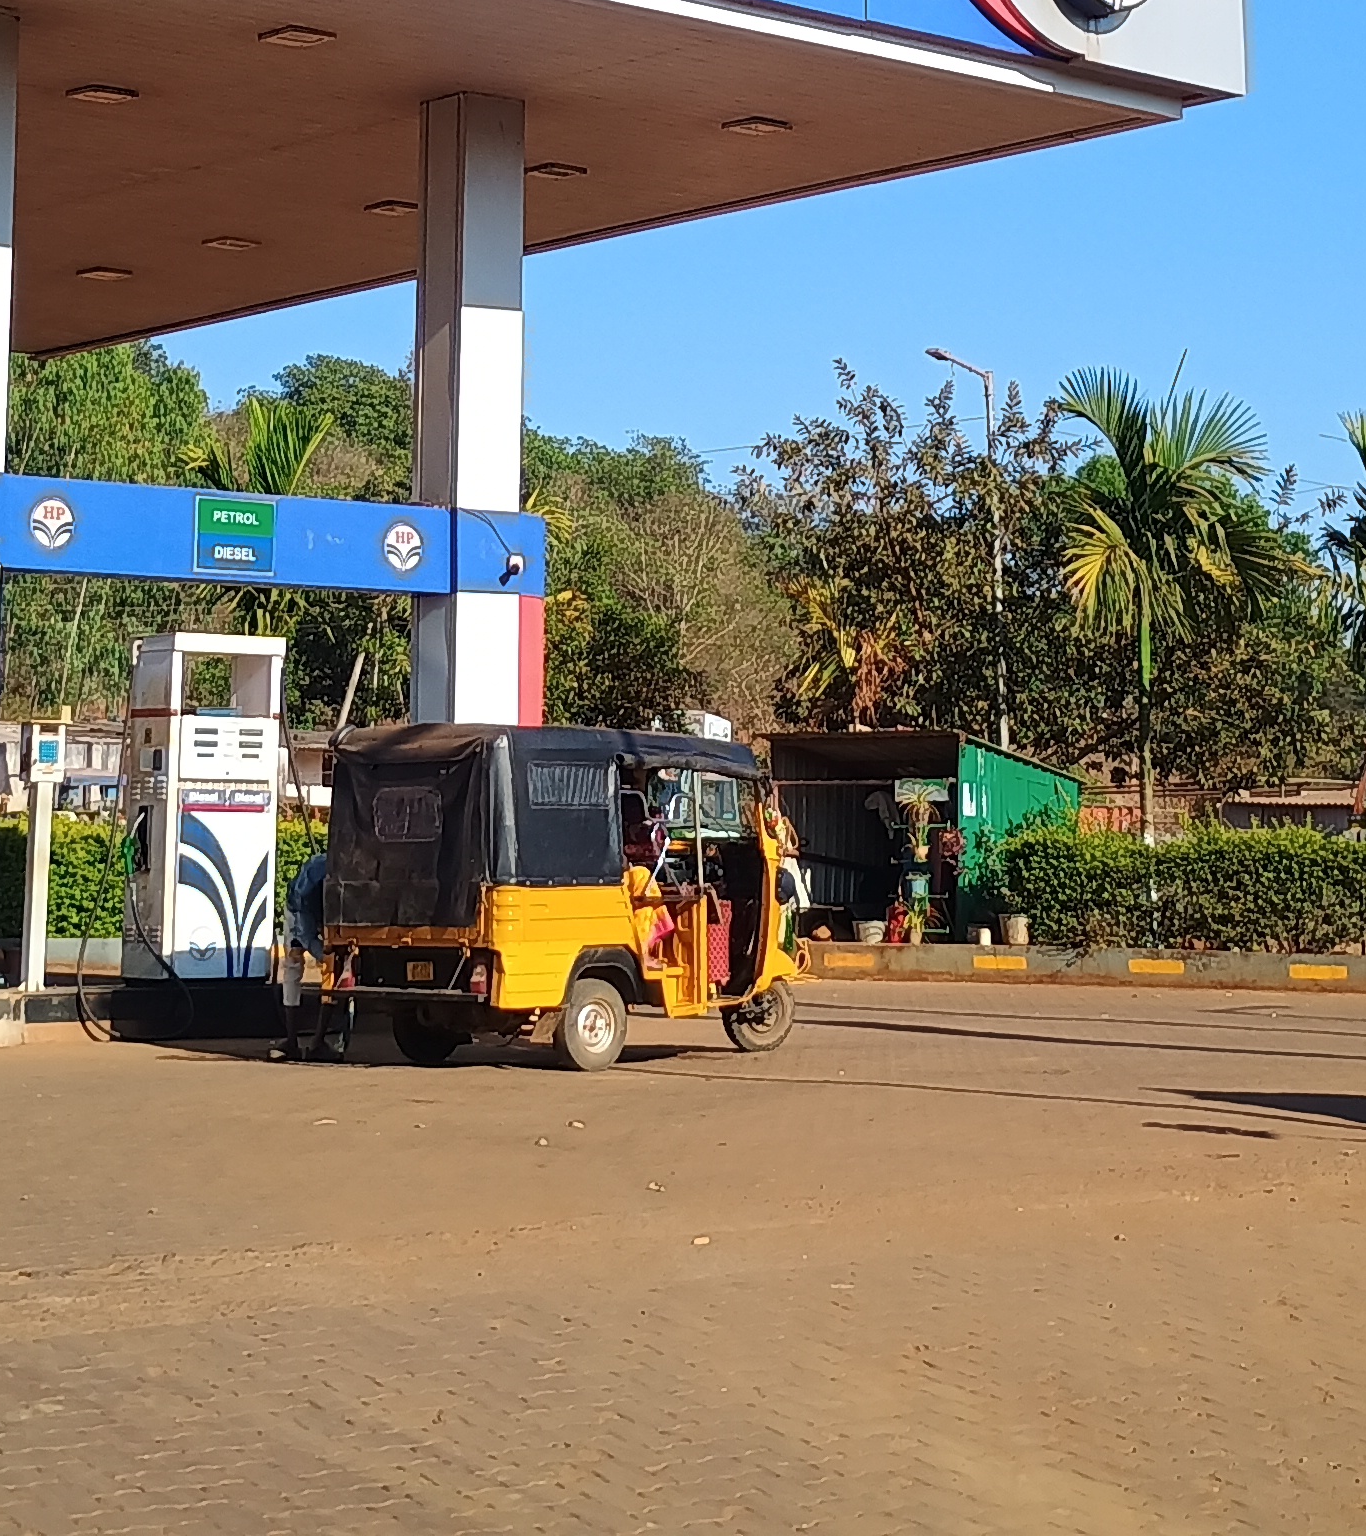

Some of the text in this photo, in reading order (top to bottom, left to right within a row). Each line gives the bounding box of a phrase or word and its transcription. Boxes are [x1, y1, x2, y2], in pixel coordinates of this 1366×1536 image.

[42, 505, 66, 521] HP
[213, 510, 260, 526] PETROL
[394, 530, 415, 545] HP
[213, 545, 257, 562] DIESEL
